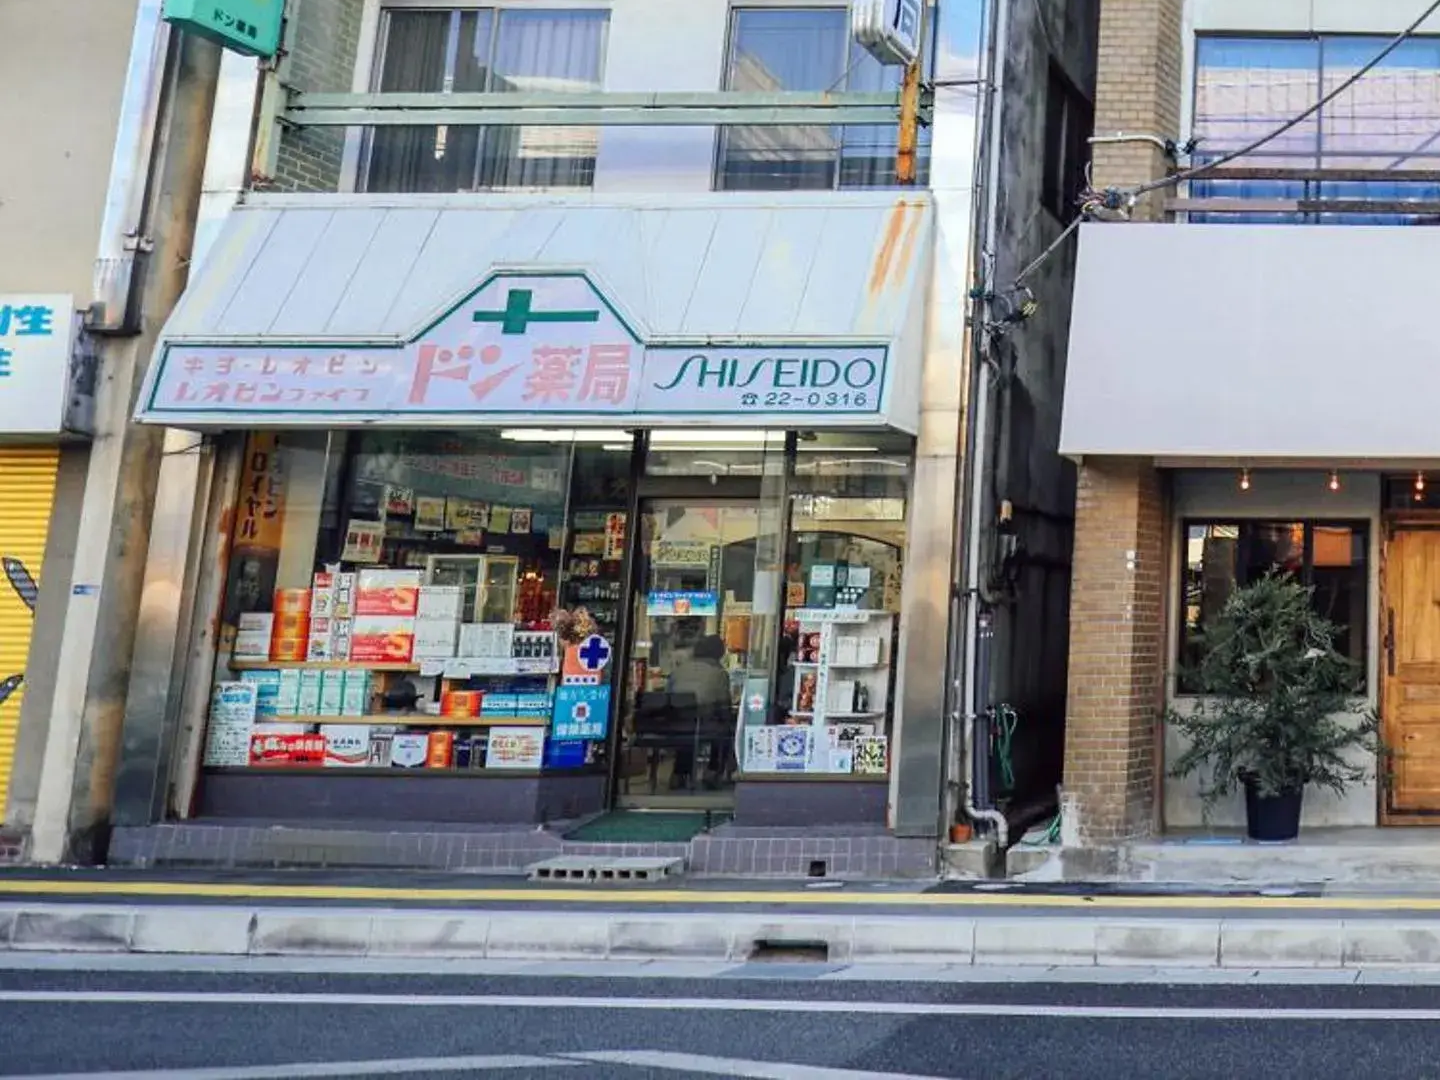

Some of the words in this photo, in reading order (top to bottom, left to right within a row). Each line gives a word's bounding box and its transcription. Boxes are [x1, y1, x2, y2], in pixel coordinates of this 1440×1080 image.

[407, 343, 632, 406] ドン薬局
[653, 353, 877, 390] SHISEIDO
